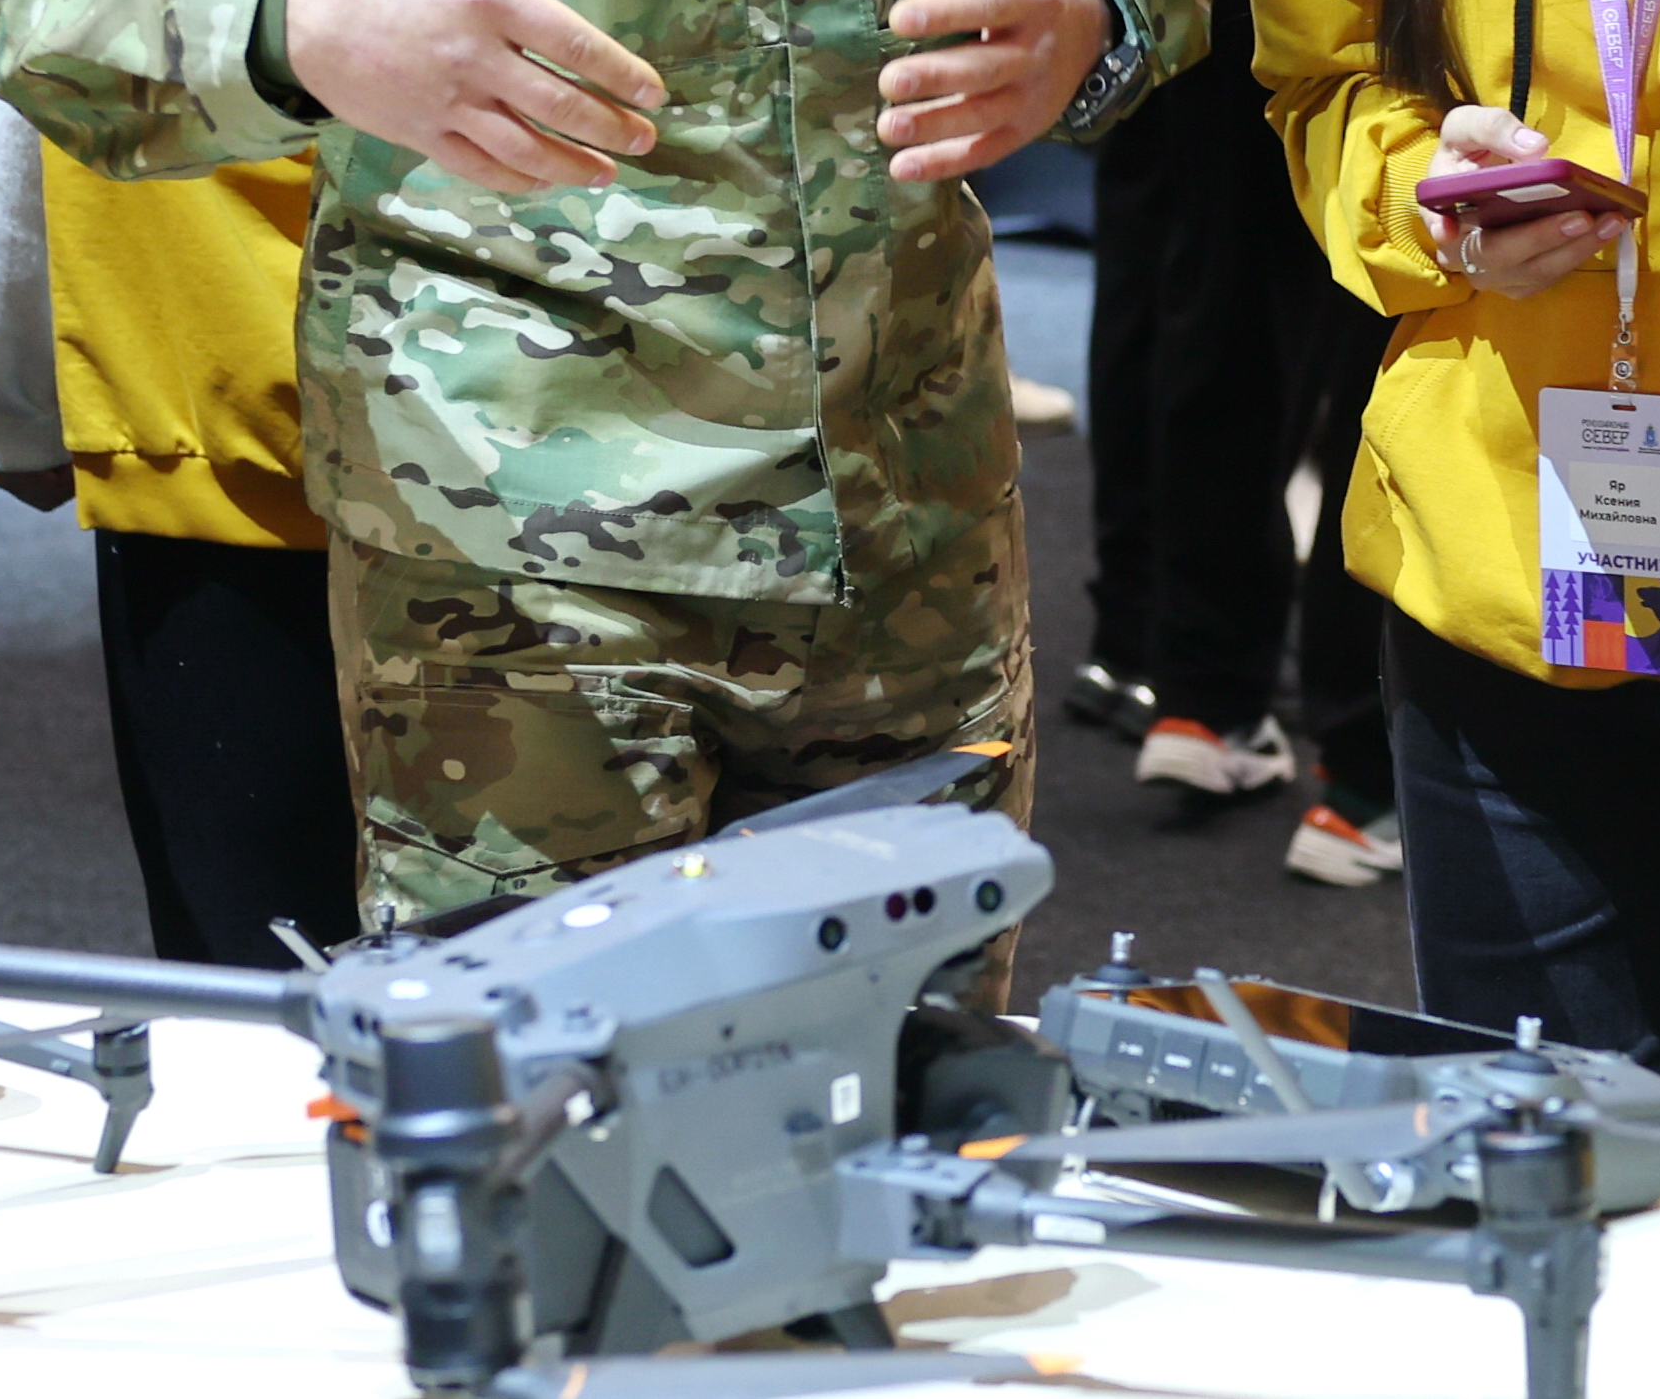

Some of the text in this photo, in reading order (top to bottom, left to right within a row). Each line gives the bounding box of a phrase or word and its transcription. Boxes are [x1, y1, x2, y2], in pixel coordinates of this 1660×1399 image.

[1602, 8, 1625, 70] СЕВЕР
[1582, 428, 1629, 445] СЕВЕР
[1609, 480, 1626, 493] Яр
[1595, 494, 1641, 508] Ксения
[1580, 508, 1658, 525] Михайловна
